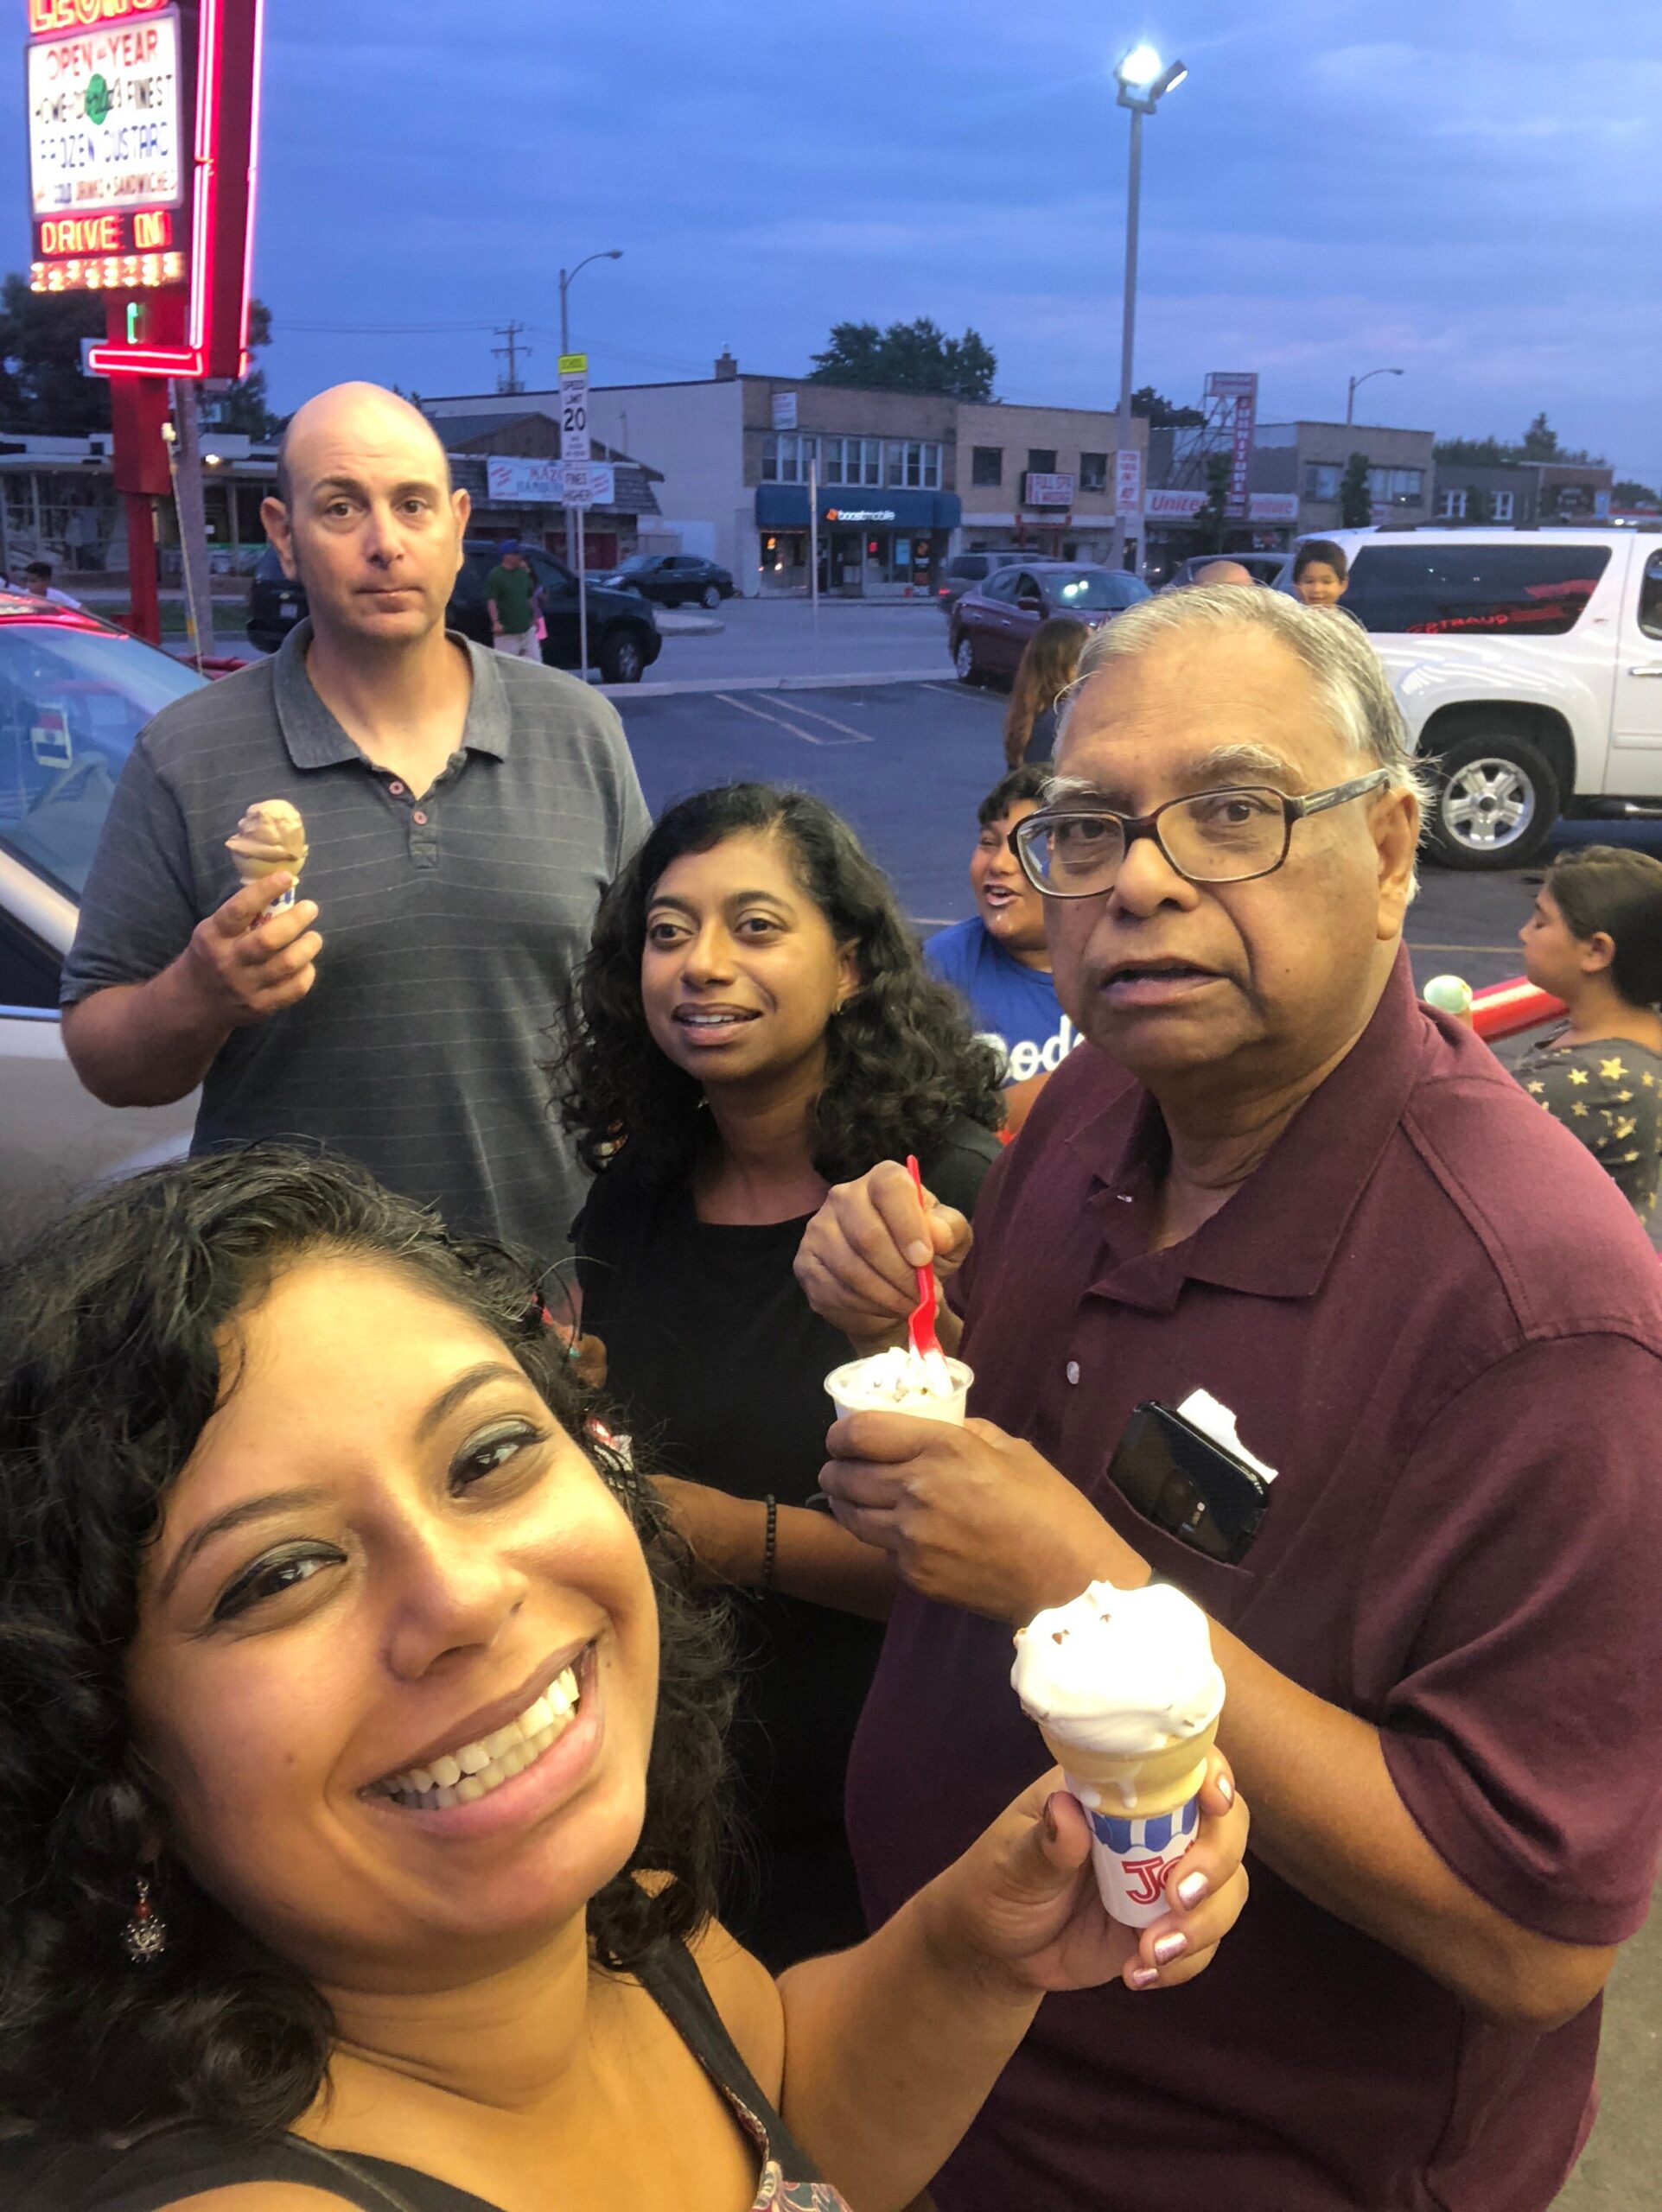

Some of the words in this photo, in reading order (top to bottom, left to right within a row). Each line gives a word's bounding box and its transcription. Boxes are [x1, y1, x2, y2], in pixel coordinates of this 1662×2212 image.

[41, 216, 119, 255] DRIVE
[134, 211, 166, 250] IN
[564, 406, 586, 431] 20
[565, 472, 587, 486] FINES
